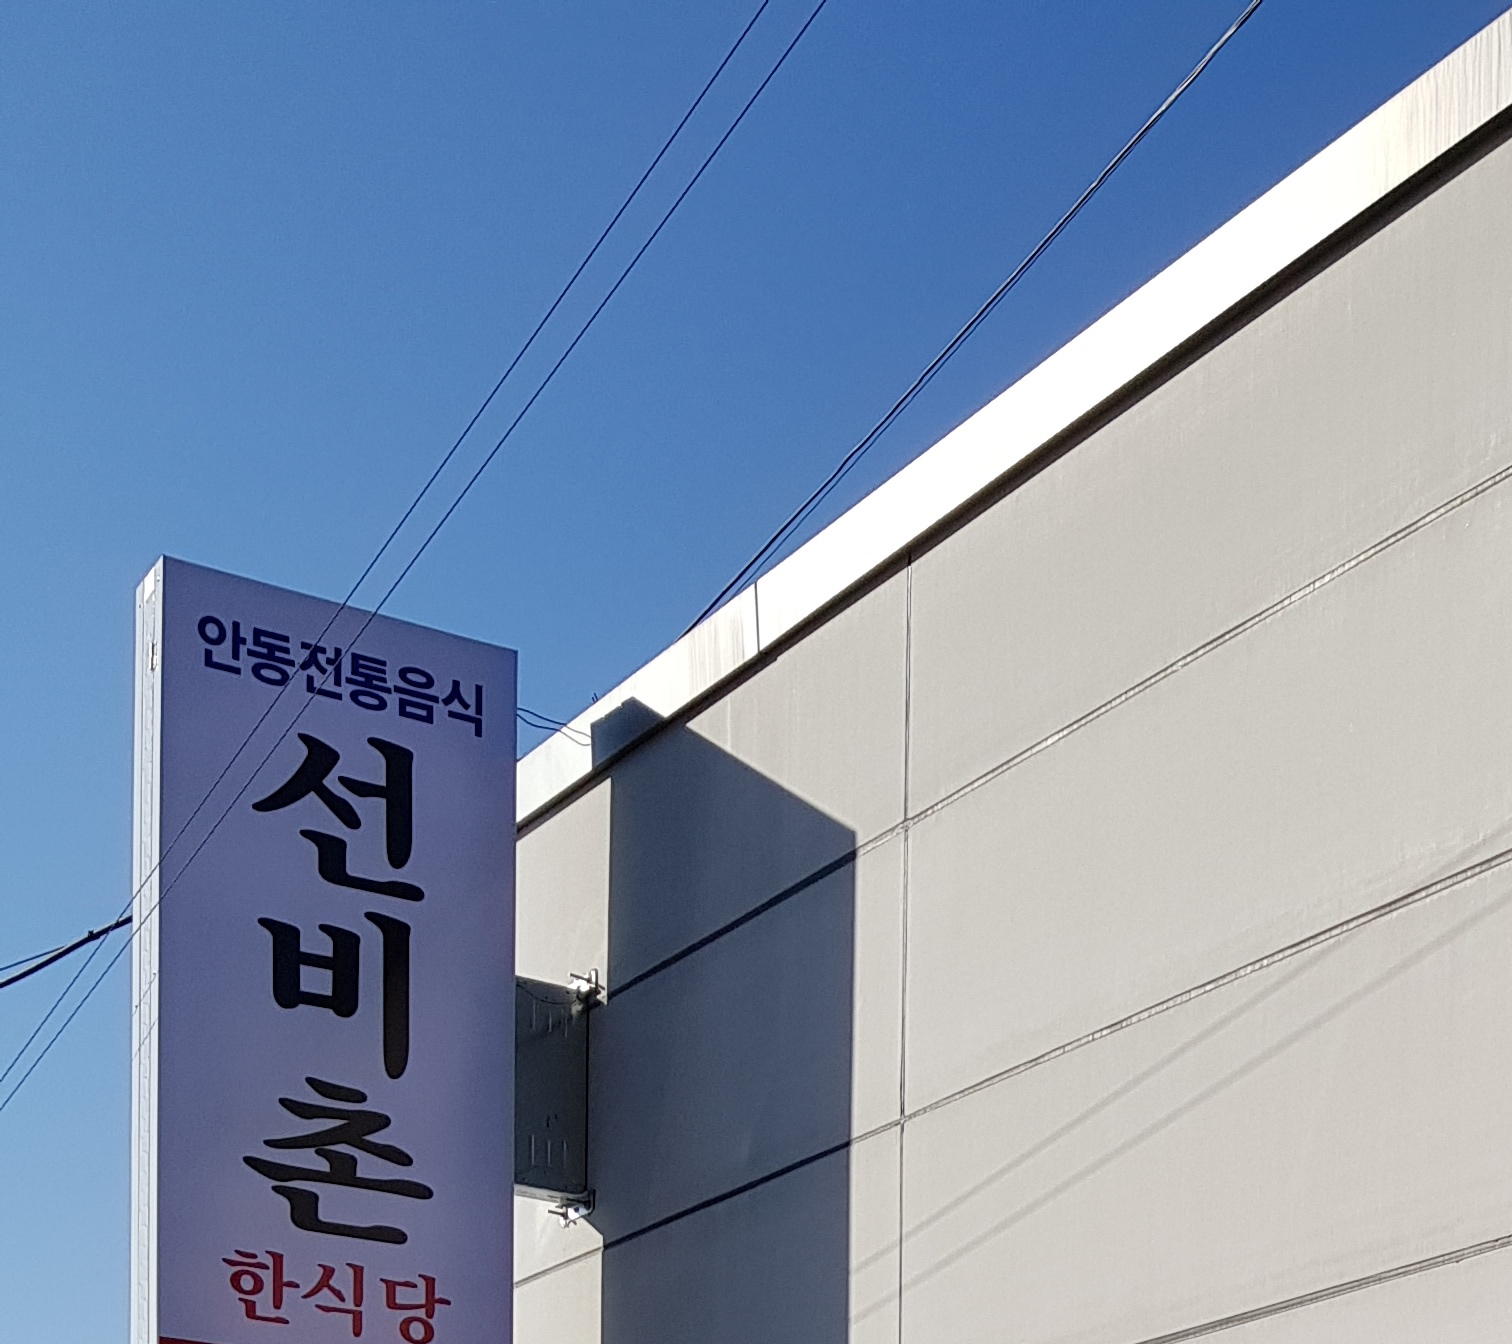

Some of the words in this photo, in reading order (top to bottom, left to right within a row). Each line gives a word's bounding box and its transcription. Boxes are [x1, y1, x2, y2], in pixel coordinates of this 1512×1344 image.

[197, 615, 483, 738] 안동전통음식
[243, 732, 434, 1245] 선비촌
[221, 1249, 451, 1344] 한식당
